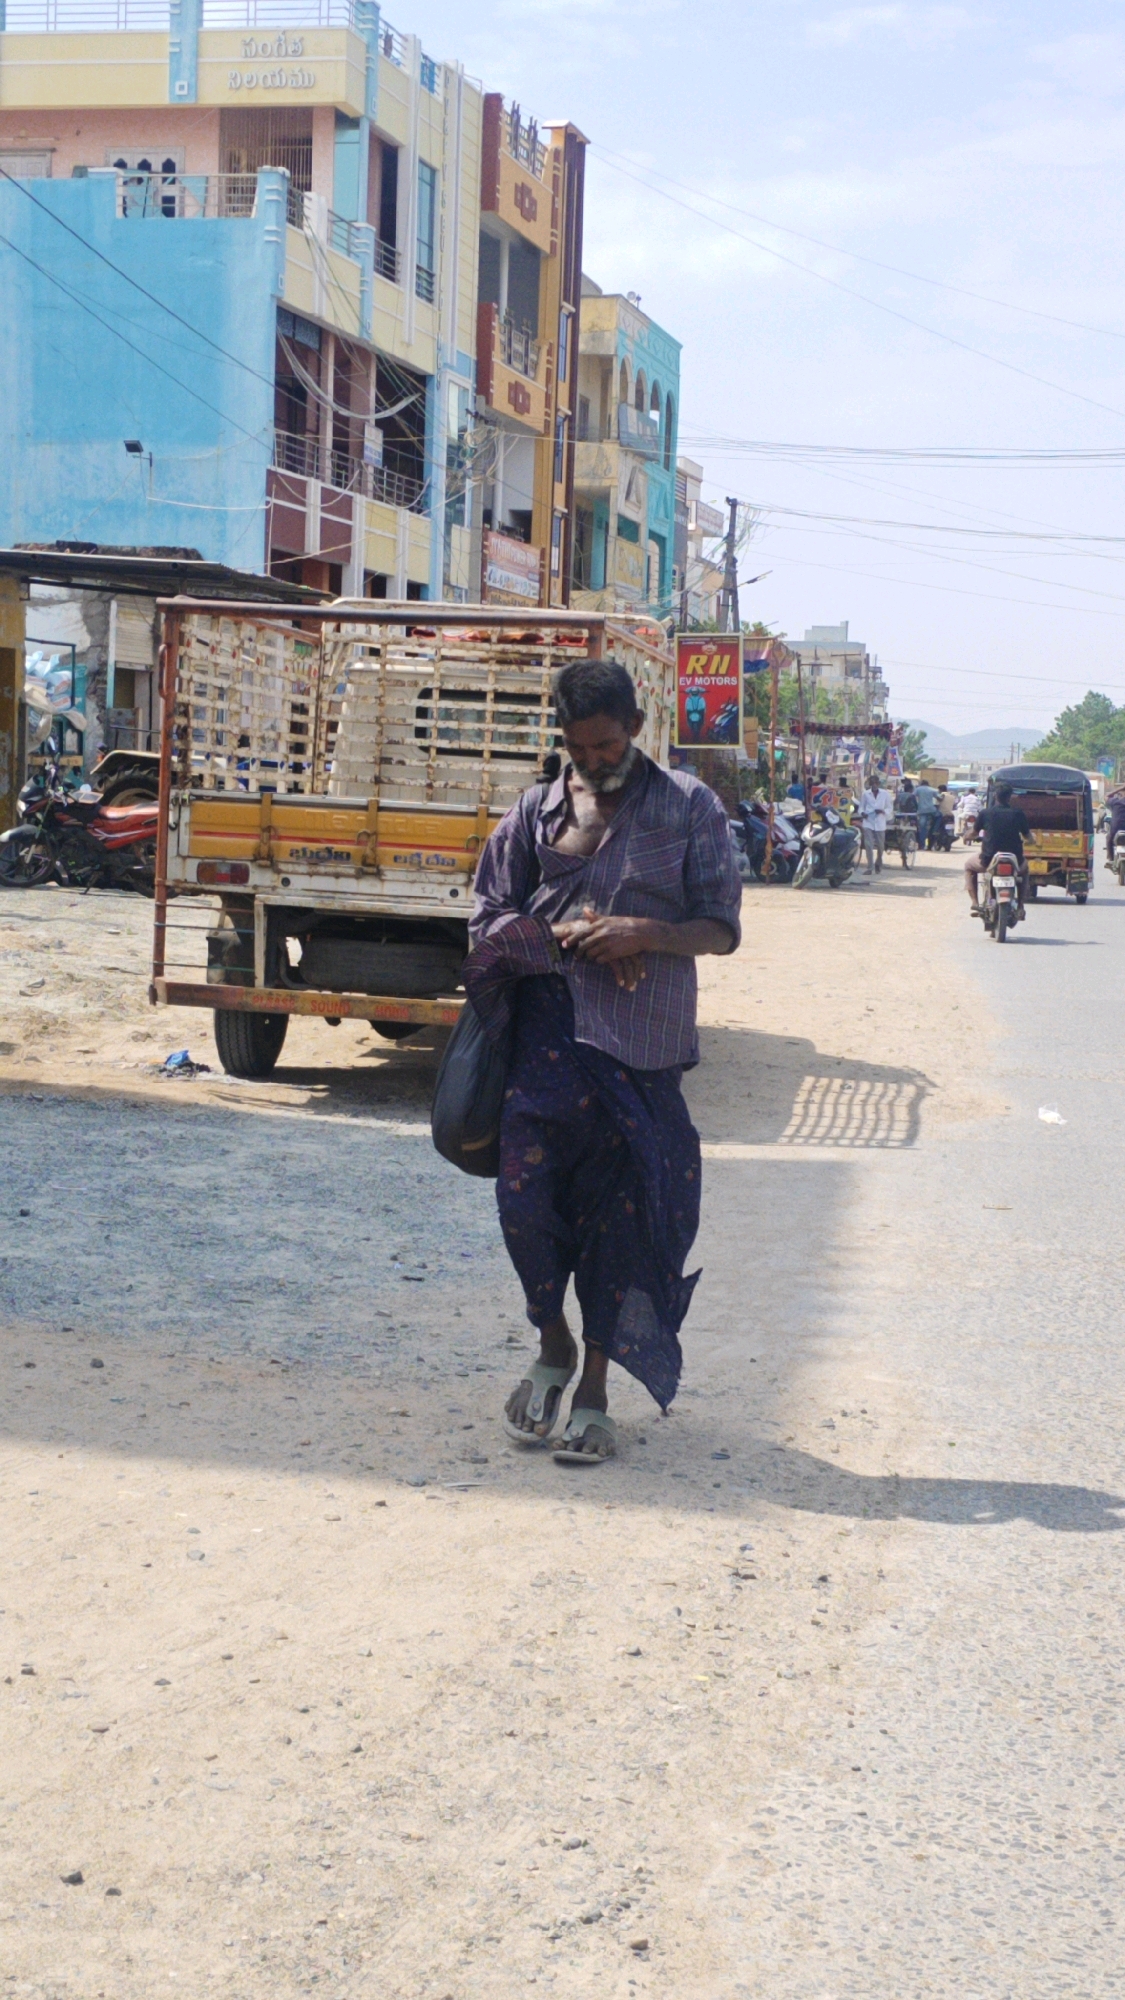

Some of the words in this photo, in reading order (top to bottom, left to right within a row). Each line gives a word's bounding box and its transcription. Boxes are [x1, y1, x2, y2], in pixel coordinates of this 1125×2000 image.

[241, 30, 304, 58] సంగీత
[227, 67, 315, 89] నిలయము
[686, 654, 731, 675] RN
[679, 677, 692, 686] EV
[695, 676, 738, 686] MOTORS
[252, 994, 297, 1012] PLEASE
[310, 999, 351, 1015] SOUND
[374, 1003, 410, 1020] HORN
